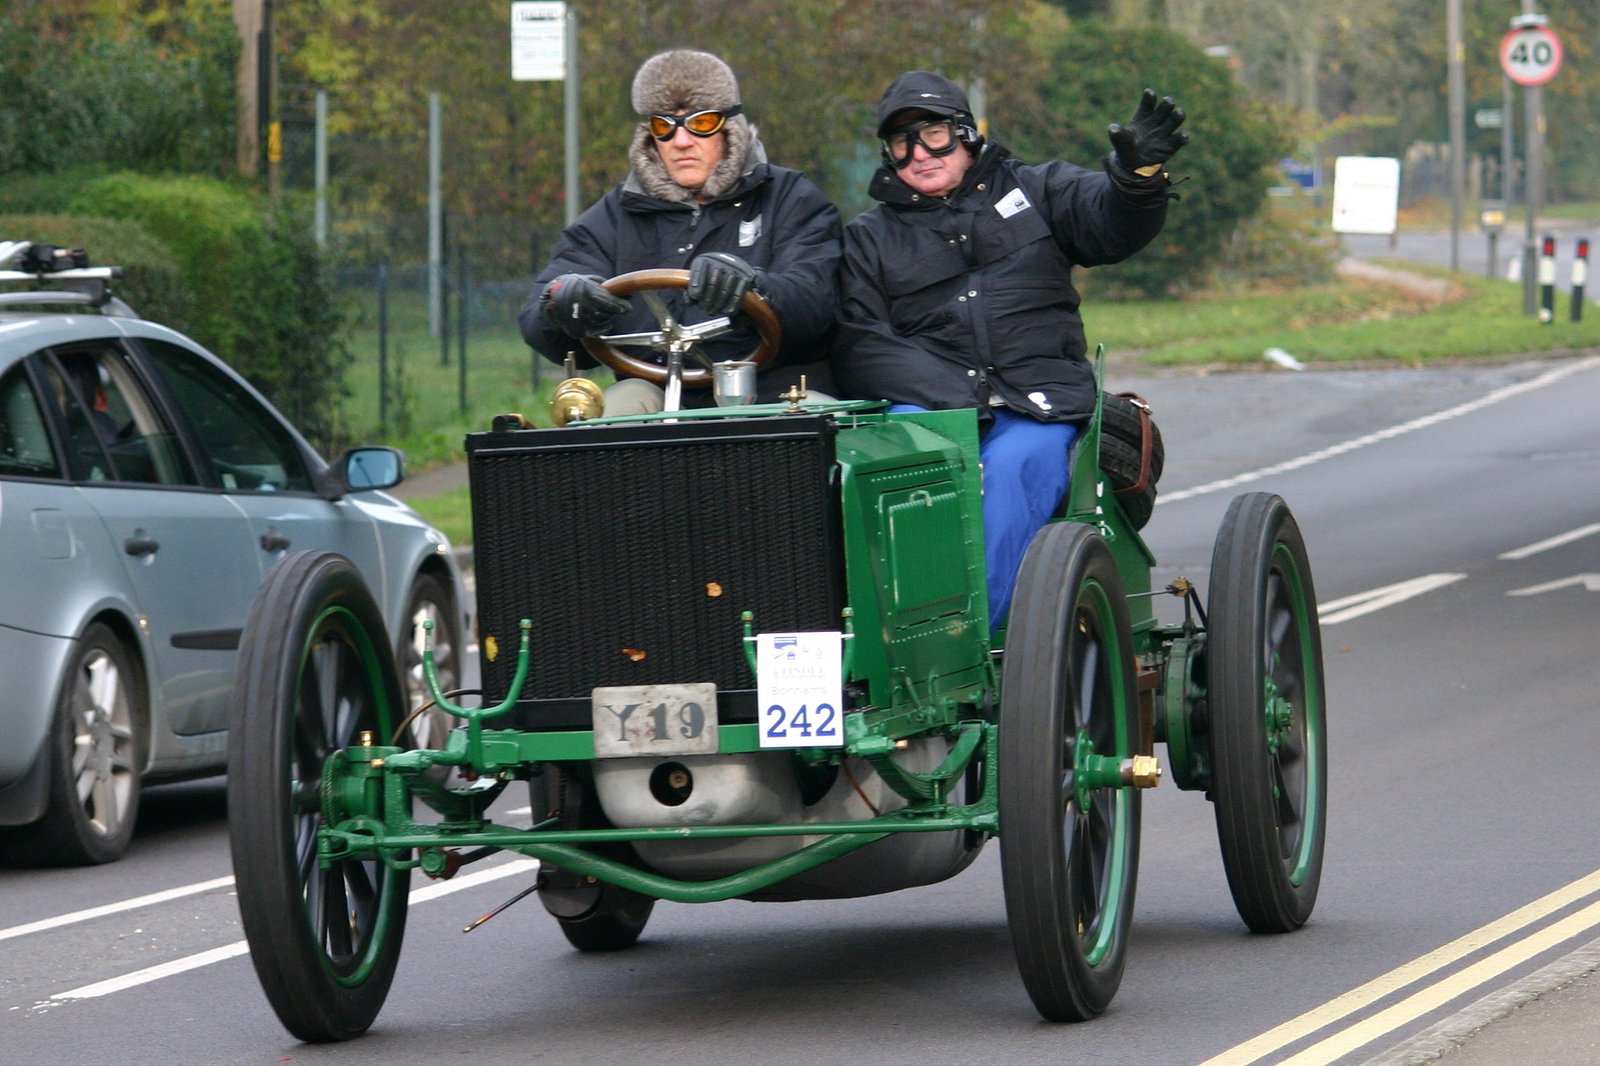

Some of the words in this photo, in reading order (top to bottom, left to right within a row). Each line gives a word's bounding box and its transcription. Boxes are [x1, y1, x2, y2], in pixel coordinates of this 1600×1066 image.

[1510, 41, 1552, 65] 40
[600, 702, 705, 742] Y19
[767, 703, 836, 738] 242
